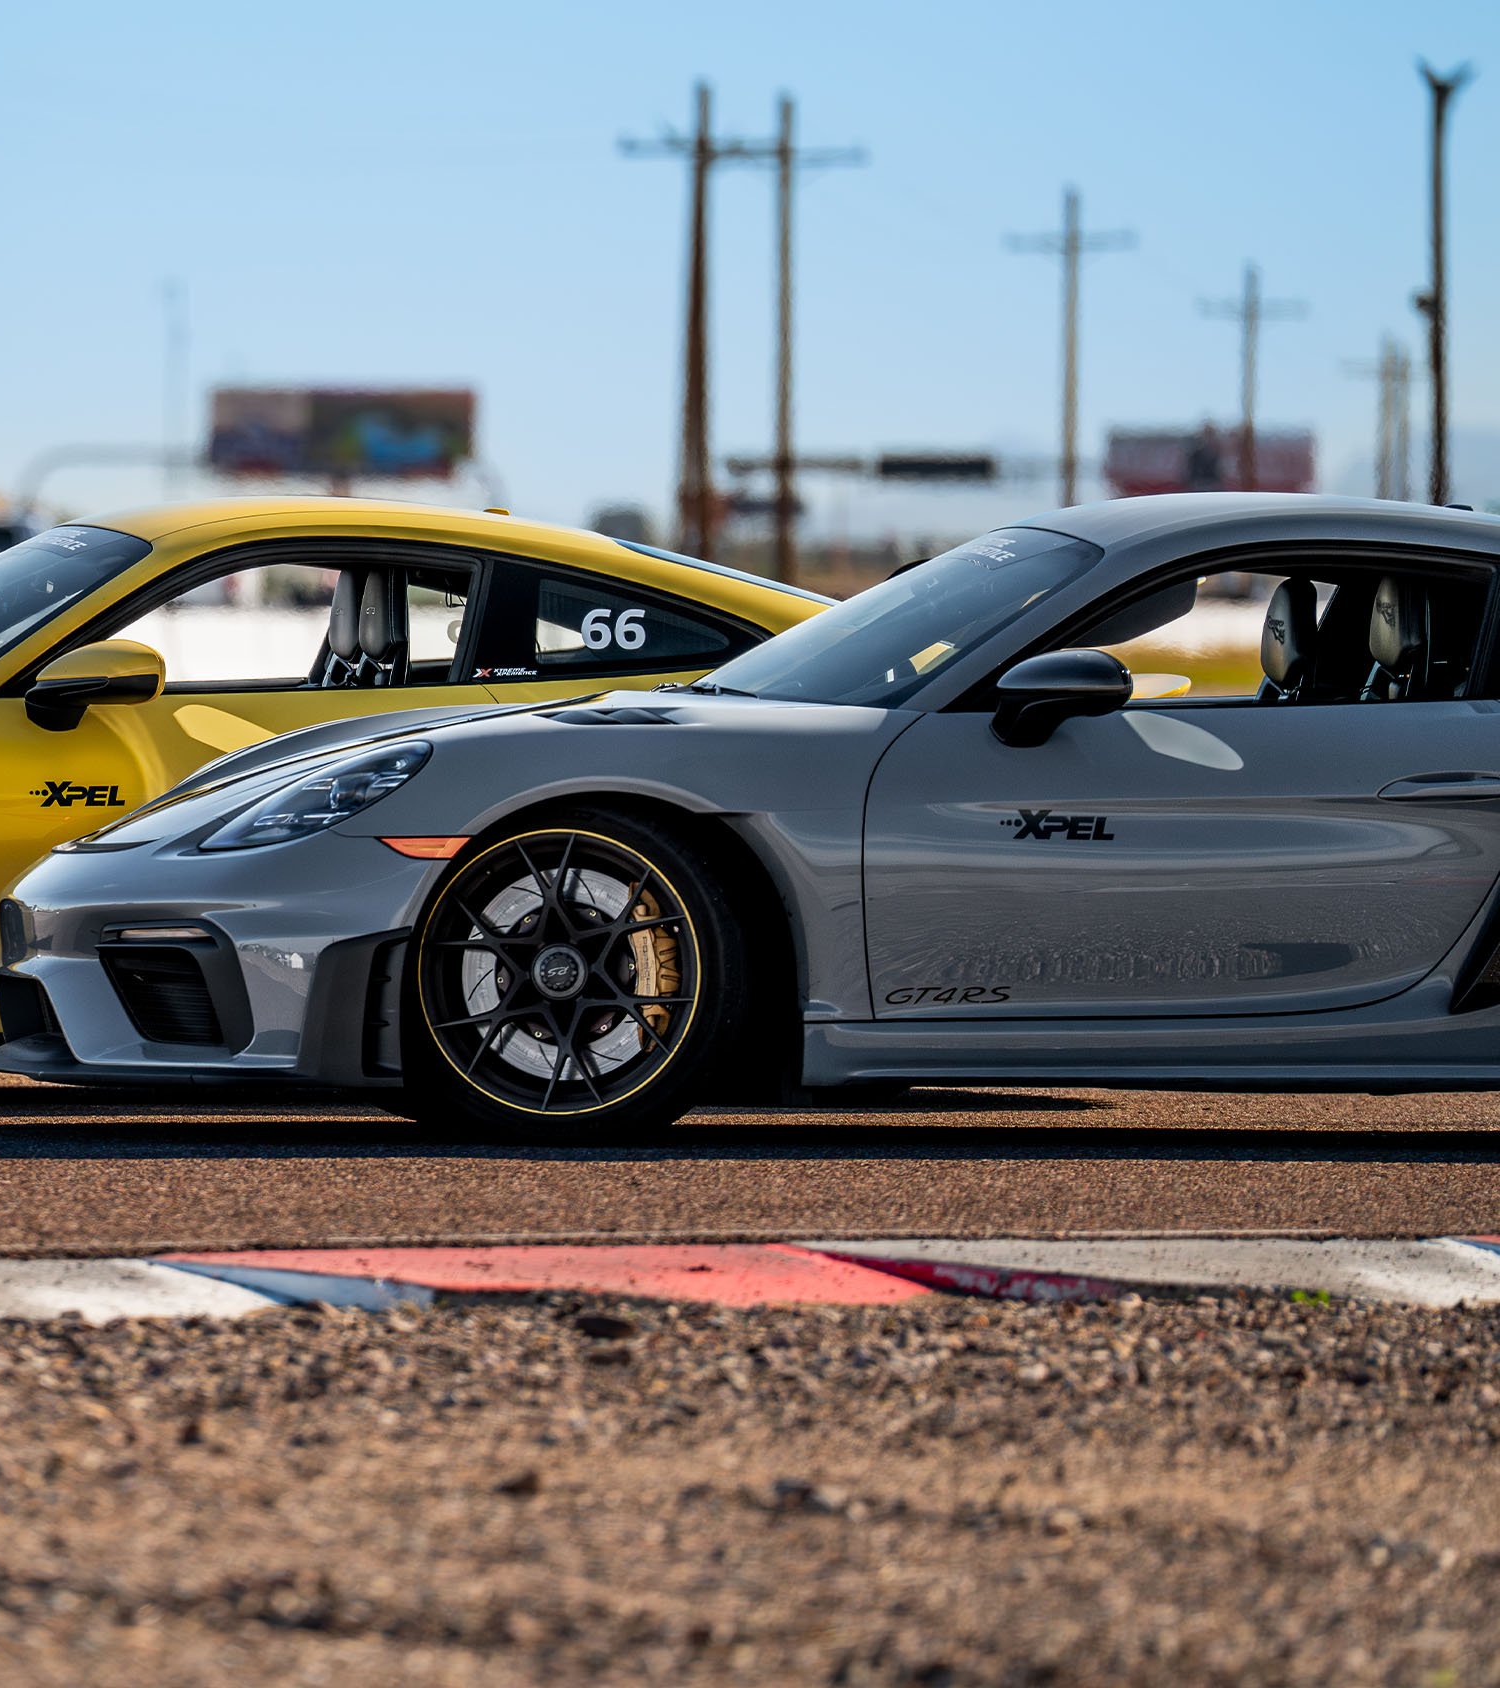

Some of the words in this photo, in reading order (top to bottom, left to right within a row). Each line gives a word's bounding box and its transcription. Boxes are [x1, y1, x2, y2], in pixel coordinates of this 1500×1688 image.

[581, 608, 646, 650] 66
[40, 781, 126, 807] XPEL
[1013, 809, 1115, 841] XPEL
